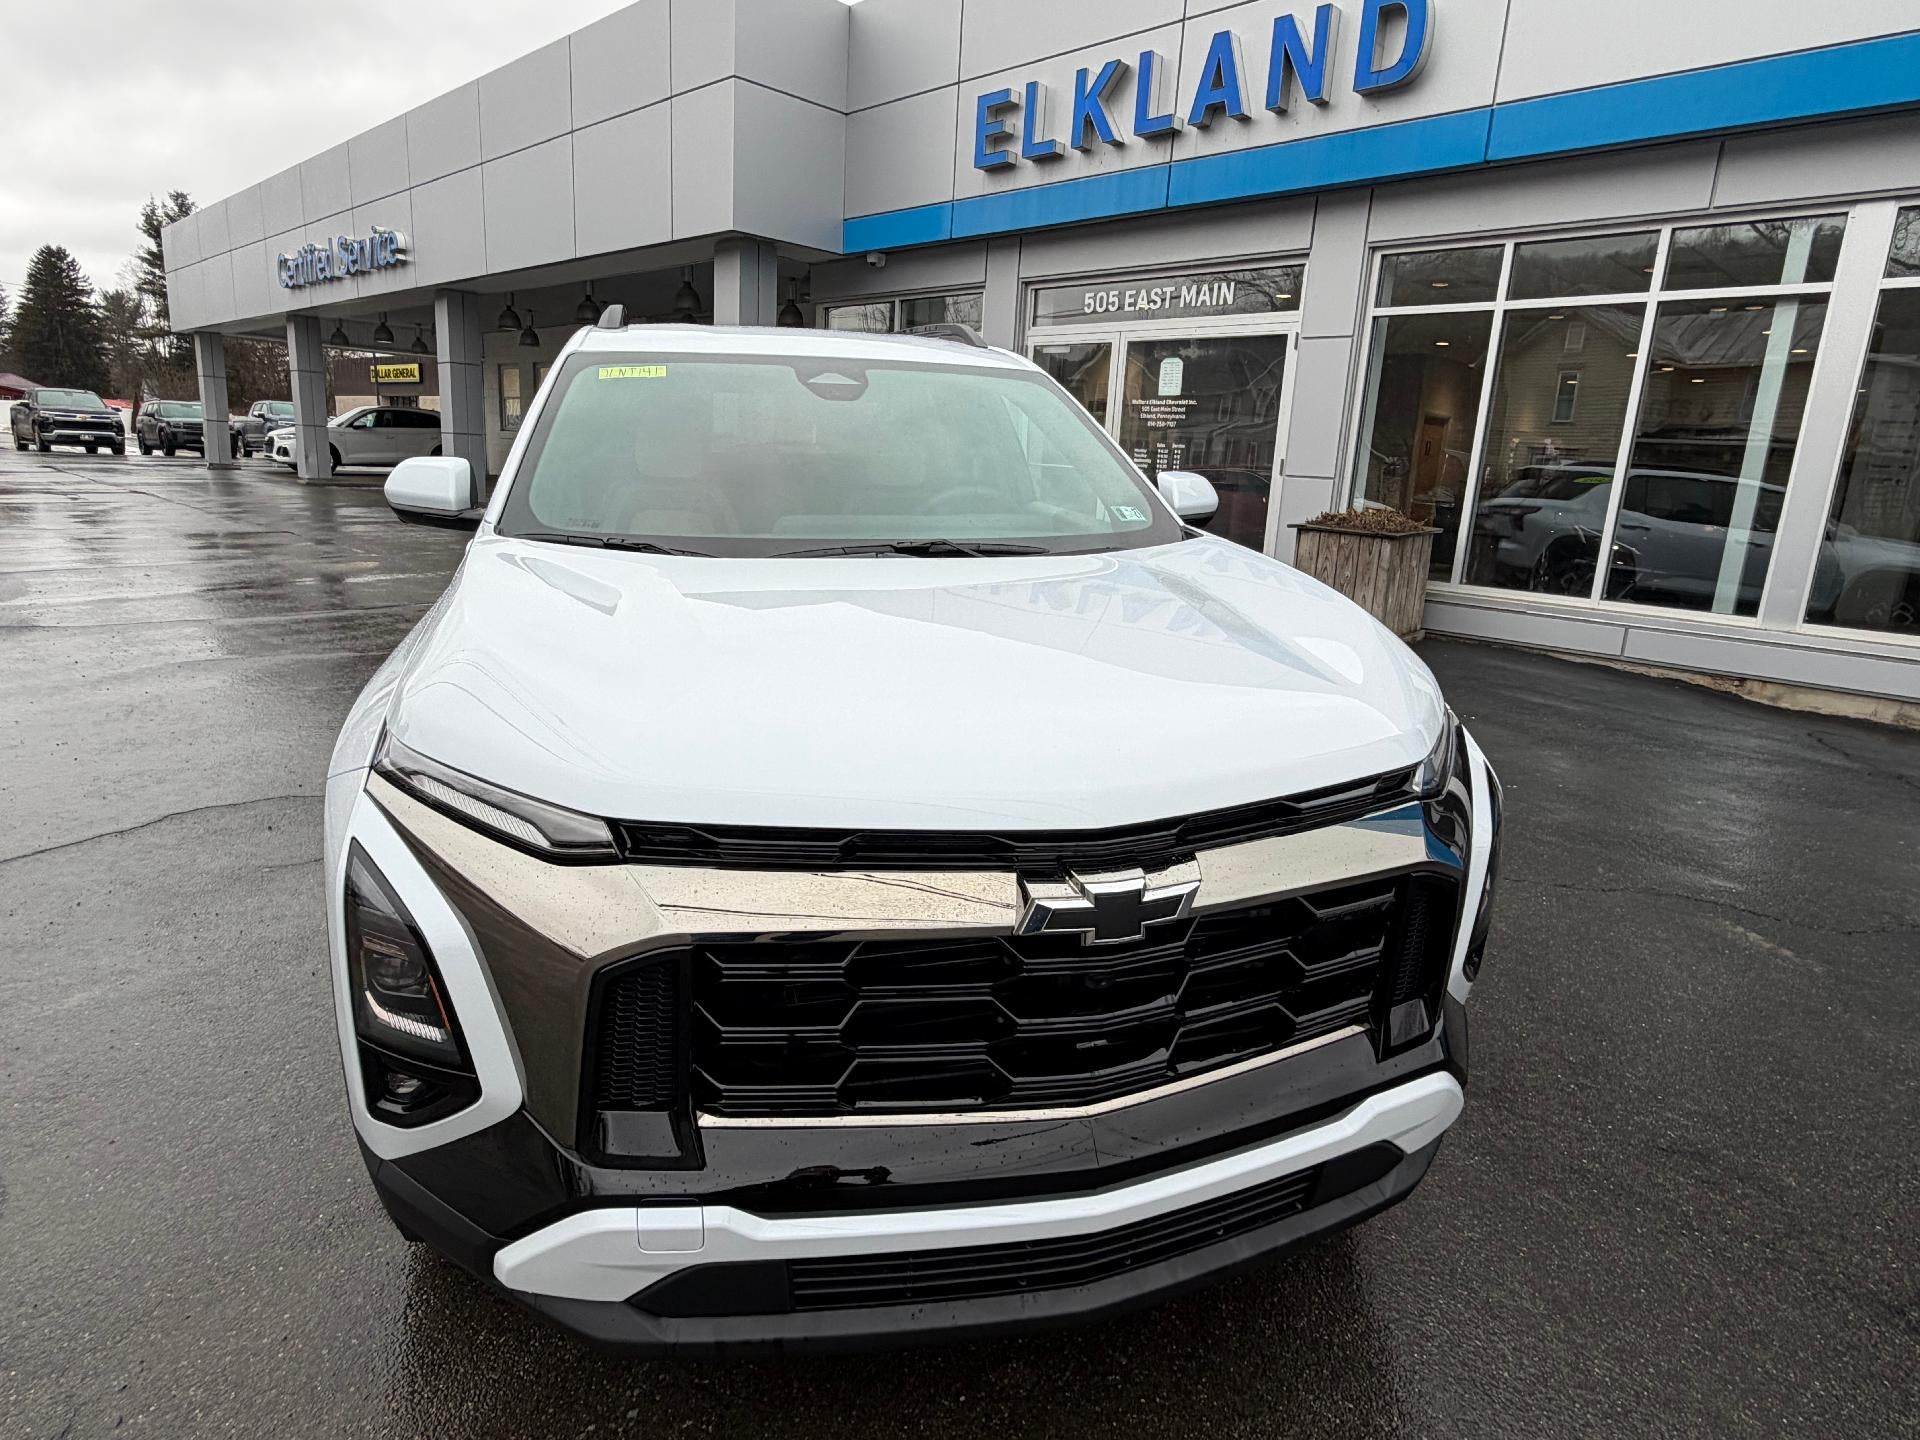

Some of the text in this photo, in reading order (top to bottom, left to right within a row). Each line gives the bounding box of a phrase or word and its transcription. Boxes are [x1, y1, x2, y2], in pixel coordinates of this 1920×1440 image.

[974, 0, 1432, 171] ELKLAND
[277, 225, 401, 288] Certified Service
[1084, 281, 1236, 313] 505 EAST MAIN
[371, 367, 417, 379] DLLAR GENERAL
